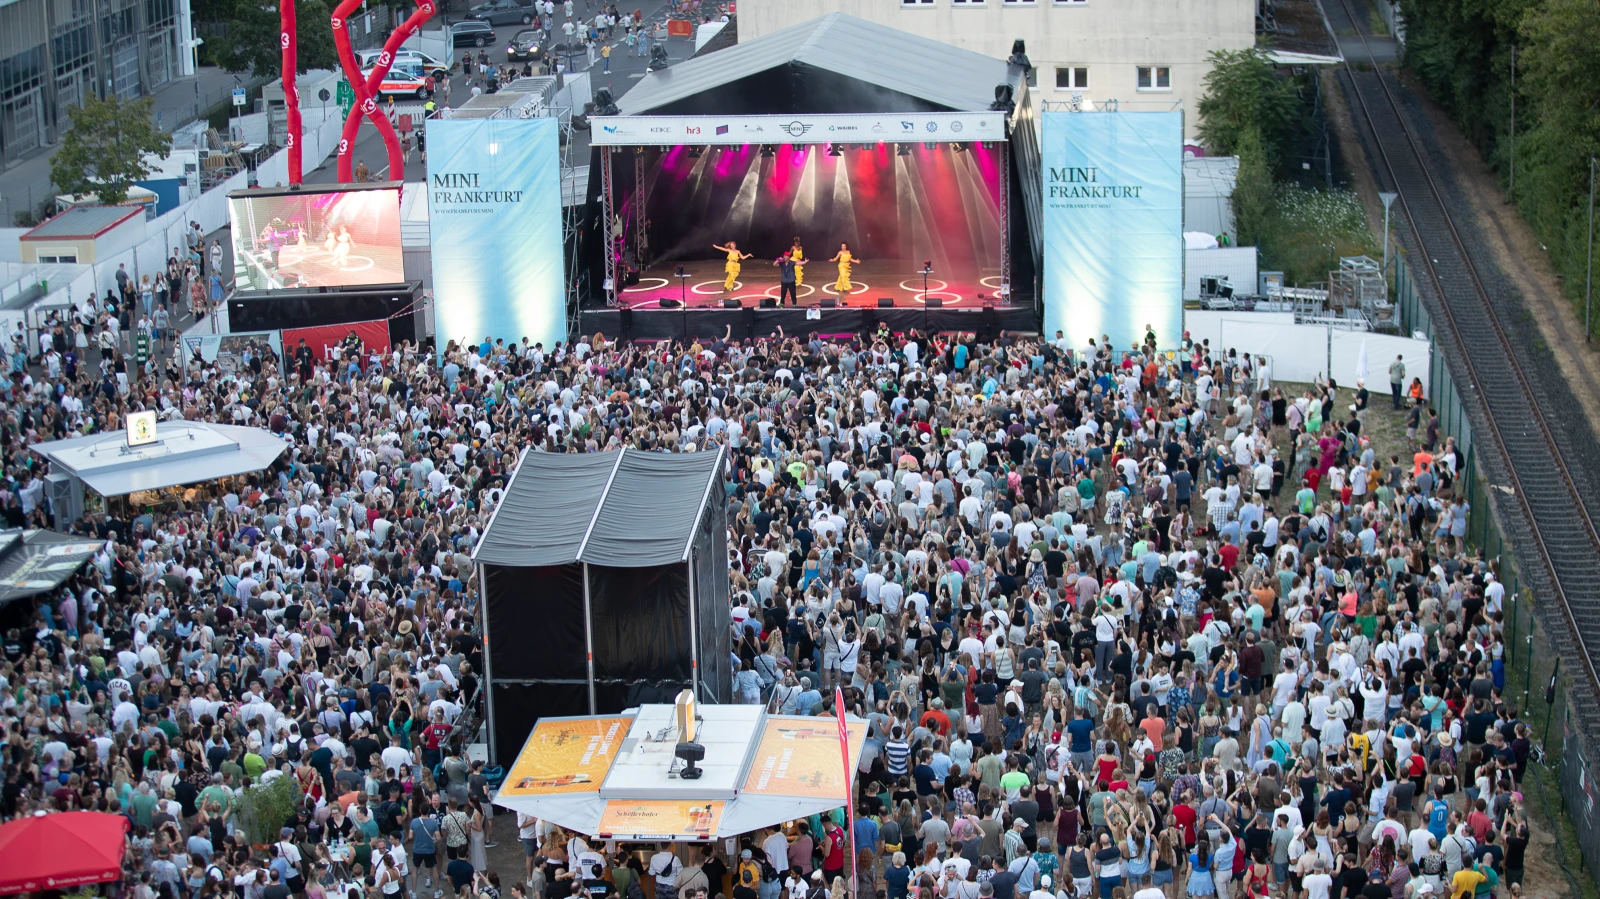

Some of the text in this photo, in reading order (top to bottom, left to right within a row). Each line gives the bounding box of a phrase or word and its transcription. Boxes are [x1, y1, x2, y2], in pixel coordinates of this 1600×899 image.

[686, 126, 700, 134] hr3
[433, 173, 480, 188] MINI
[1049, 167, 1097, 183] MINI
[434, 191, 523, 203] FRANKFURT
[1049, 186, 1142, 198] FRANKFURT
[616, 810, 659, 818] Schöfferhofer
